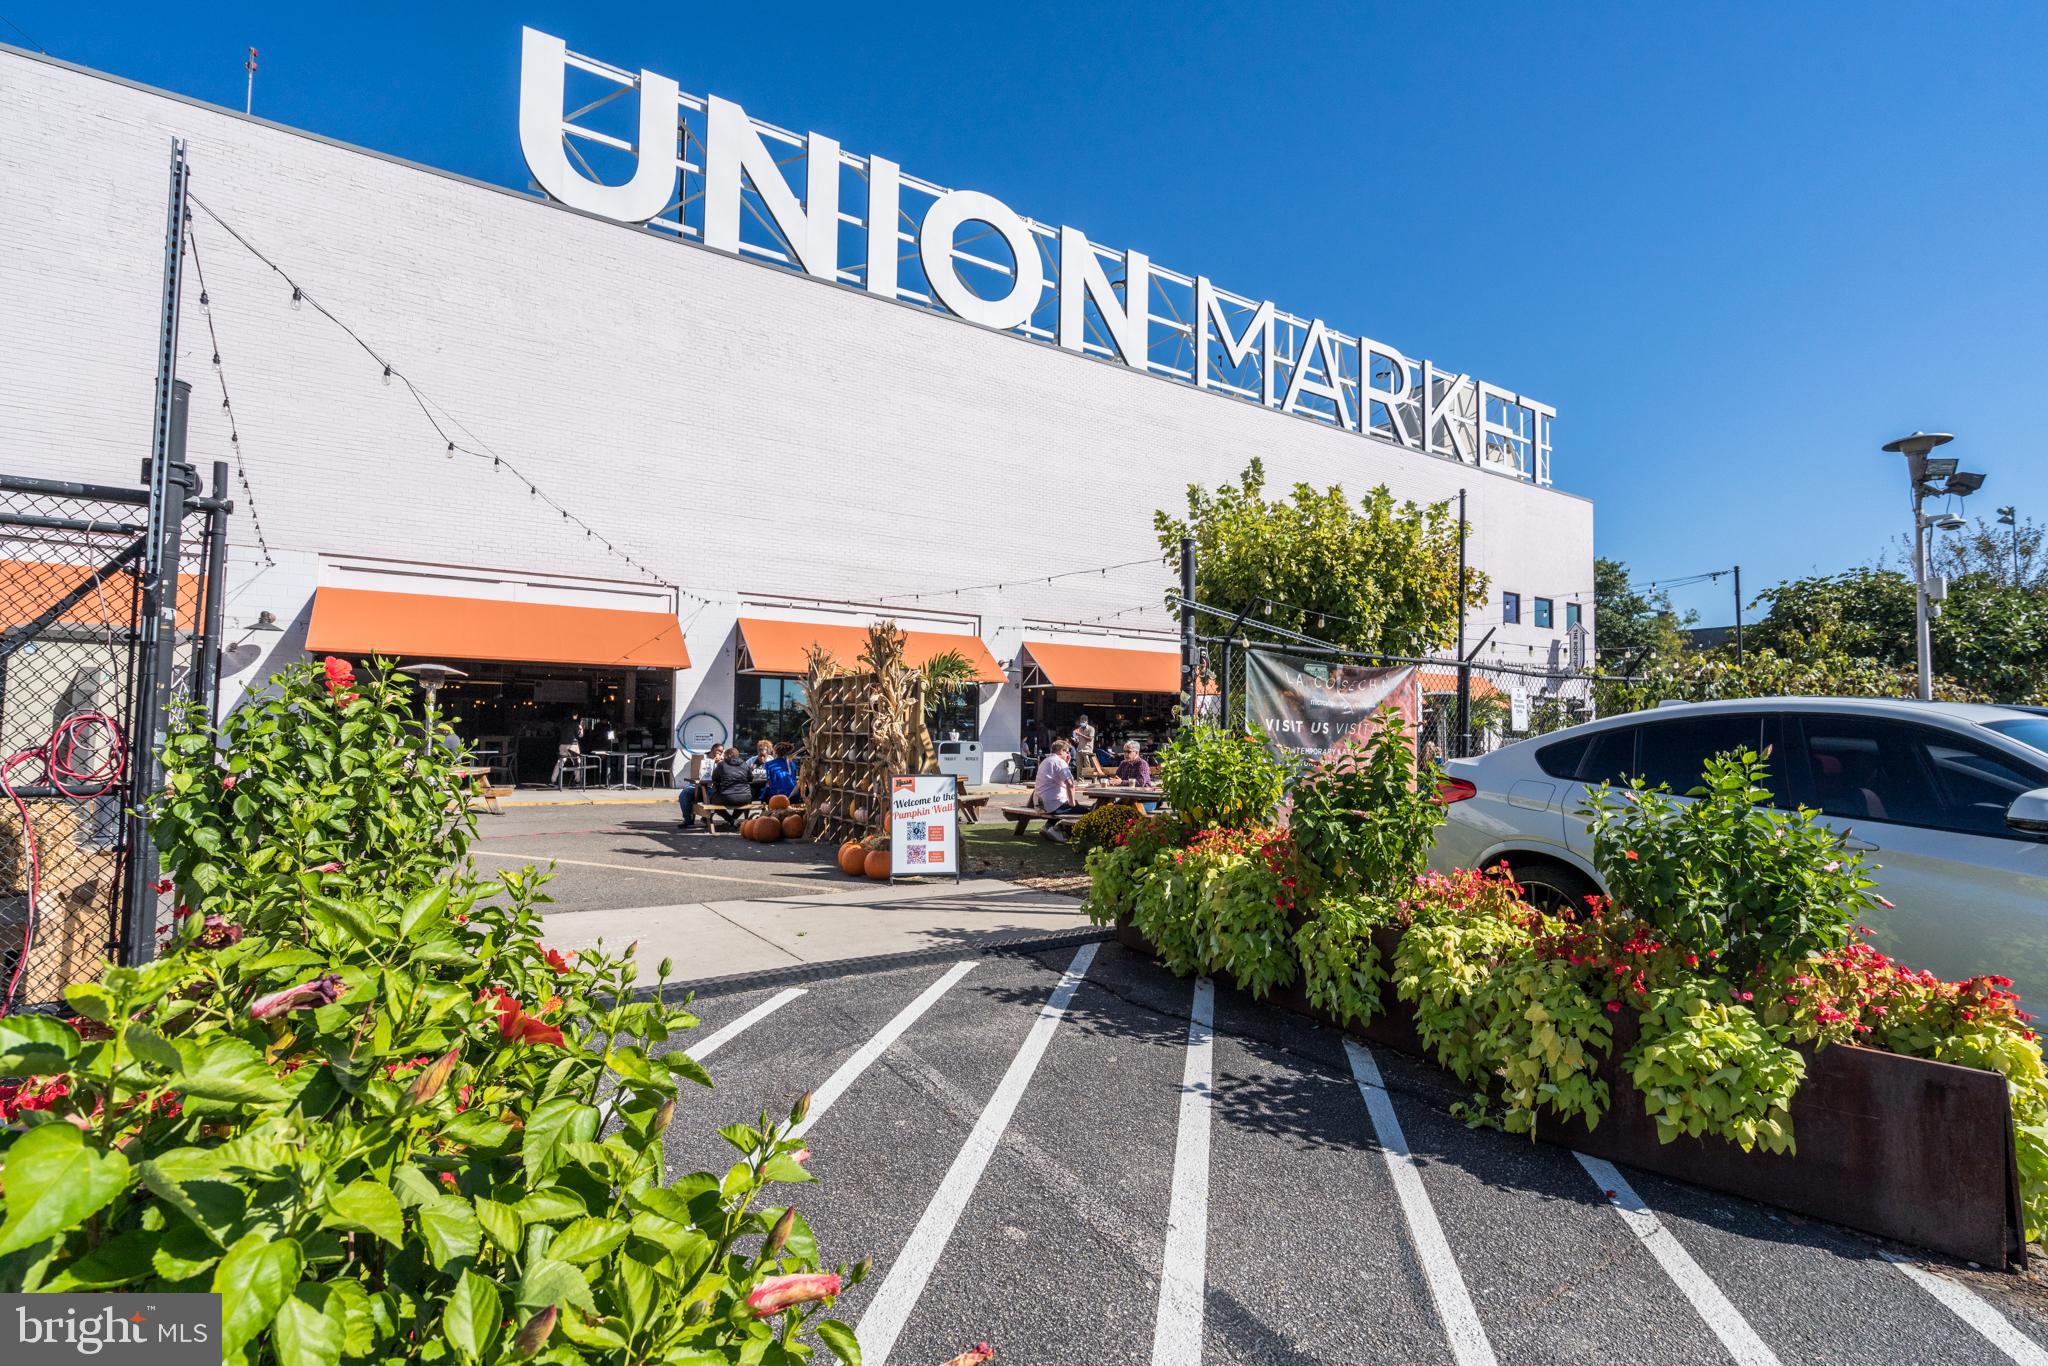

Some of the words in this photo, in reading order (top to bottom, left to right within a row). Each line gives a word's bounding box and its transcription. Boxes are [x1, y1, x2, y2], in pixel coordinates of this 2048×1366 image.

[519, 25, 1148, 371] UNION
[1196, 275, 1557, 485] MARKET
[1265, 718, 1304, 733] VISIT
[1310, 722, 1330, 735] US
[894, 798, 931, 808] Welcome
[933, 795, 940, 803] to
[943, 793, 956, 801] the
[894, 807, 930, 820] Pumpkin
